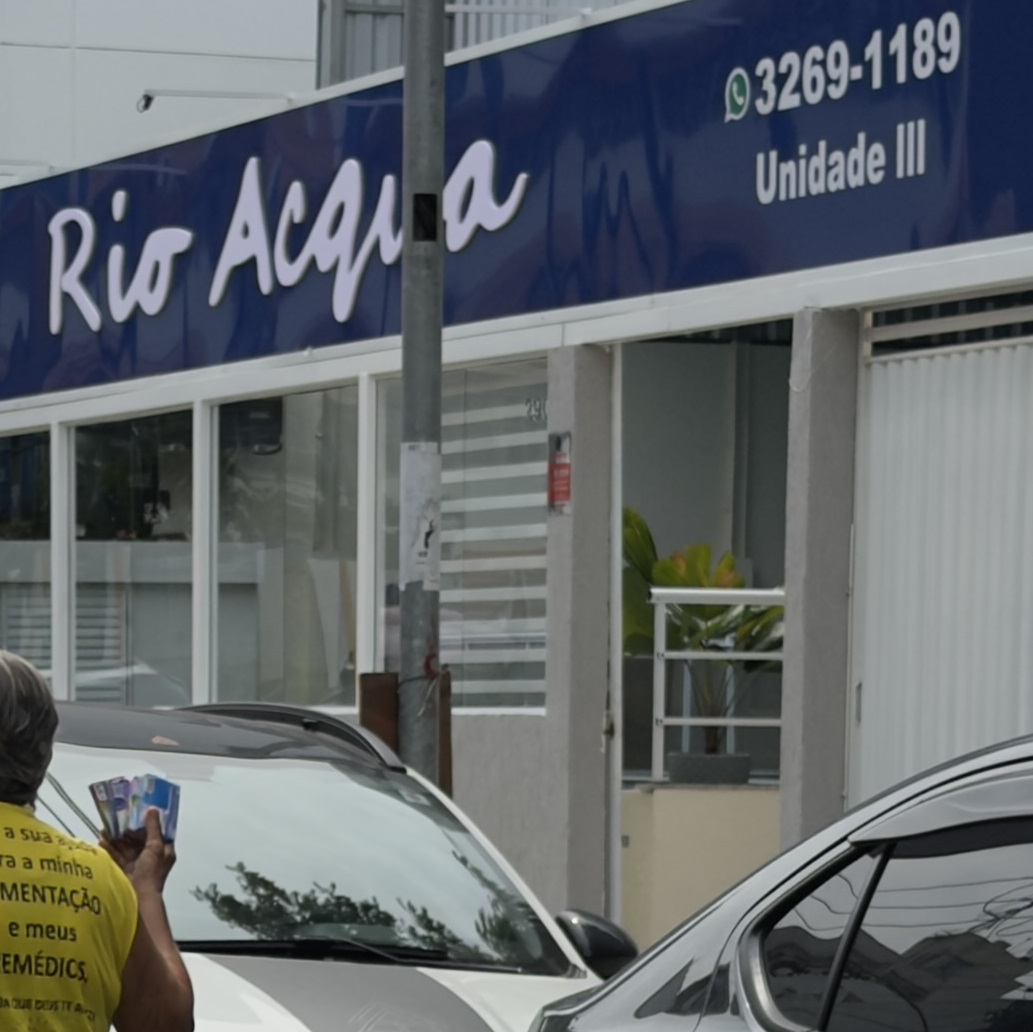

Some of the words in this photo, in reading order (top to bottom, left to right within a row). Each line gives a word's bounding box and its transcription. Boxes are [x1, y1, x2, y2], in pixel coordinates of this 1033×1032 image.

[755, 11, 961, 115] 3269-1189
[756, 131, 886, 205] Unidade
[896, 119, 925, 179] III
[48, 190, 193, 335] Rio
[4, 827, 15, 839] a
[20, 828, 52, 844] sua
[23, 857, 33, 870] a
[40, 855, 93, 880] minha
[8, 921, 19, 937] e
[26, 923, 77, 942] meus
